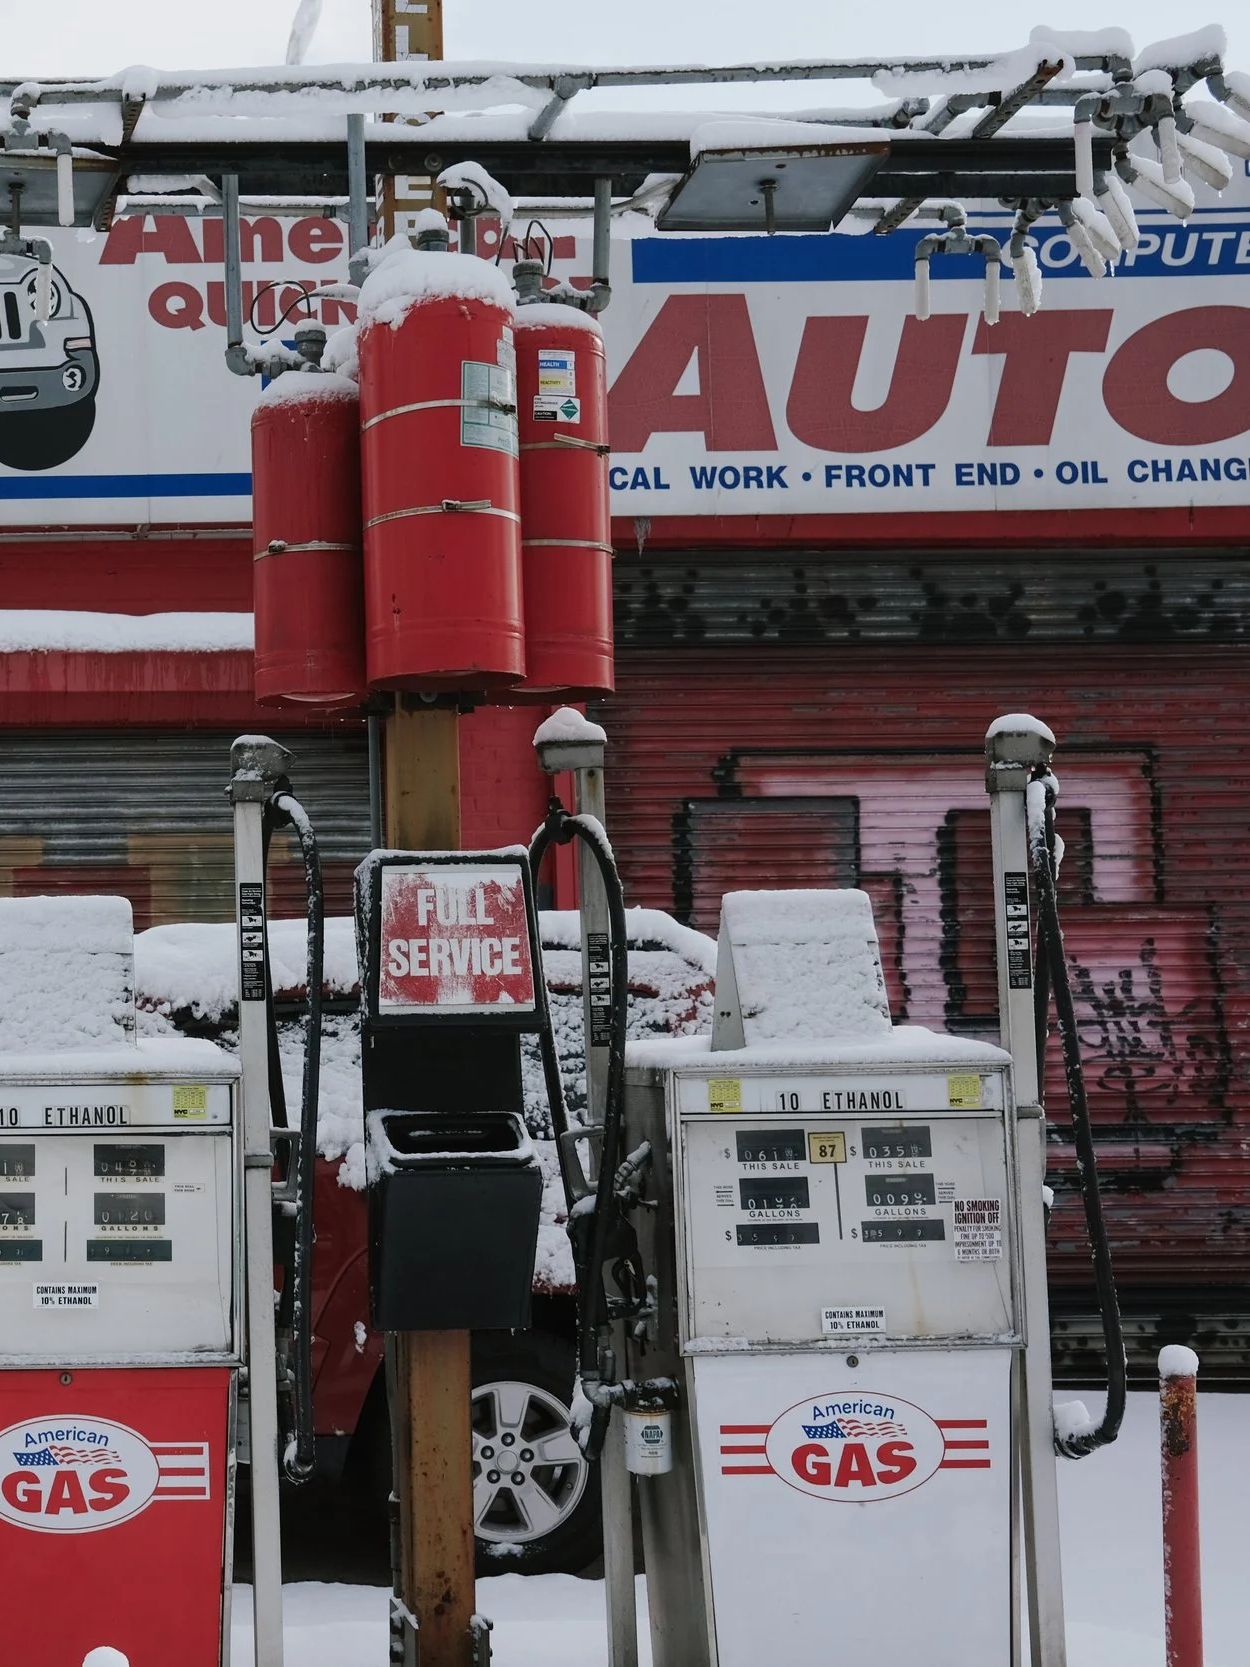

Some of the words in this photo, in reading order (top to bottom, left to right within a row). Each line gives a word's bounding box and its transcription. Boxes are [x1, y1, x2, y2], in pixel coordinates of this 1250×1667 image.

[608, 293, 1250, 453] AUTO
[689, 466, 789, 489] WORK
[825, 463, 936, 488] FRONT
[955, 462, 1020, 485] END
[1056, 460, 1108, 484] OIL
[1127, 458, 1250, 482] CHANG
[417, 888, 494, 926] FULL
[388, 937, 522, 977] SERVICE
[780, 1093, 799, 1111] 10
[823, 1091, 903, 1109] ETHANOL
[45, 1106, 128, 1125] ETHANOL
[819, 1145, 836, 1158] 87
[954, 1201, 964, 1211] NO
[967, 1200, 1000, 1211] SMOKING
[955, 1213, 985, 1224] IGNITION
[988, 1212, 999, 1223] OFF
[68, 1286, 97, 1294] MAXIMUM
[58, 1297, 92, 1305] ETHANOL
[825, 1311, 853, 1319] CONTAINS
[856, 1310, 884, 1318] MAXIMUM
[847, 1320, 880, 1329] ETHANOL
[812, 1399, 895, 1421] American
[24, 1426, 109, 1448] American
[644, 1430, 660, 1439] NAPA
[791, 1441, 917, 1488] GAS
[1, 1468, 130, 1515] GAS
